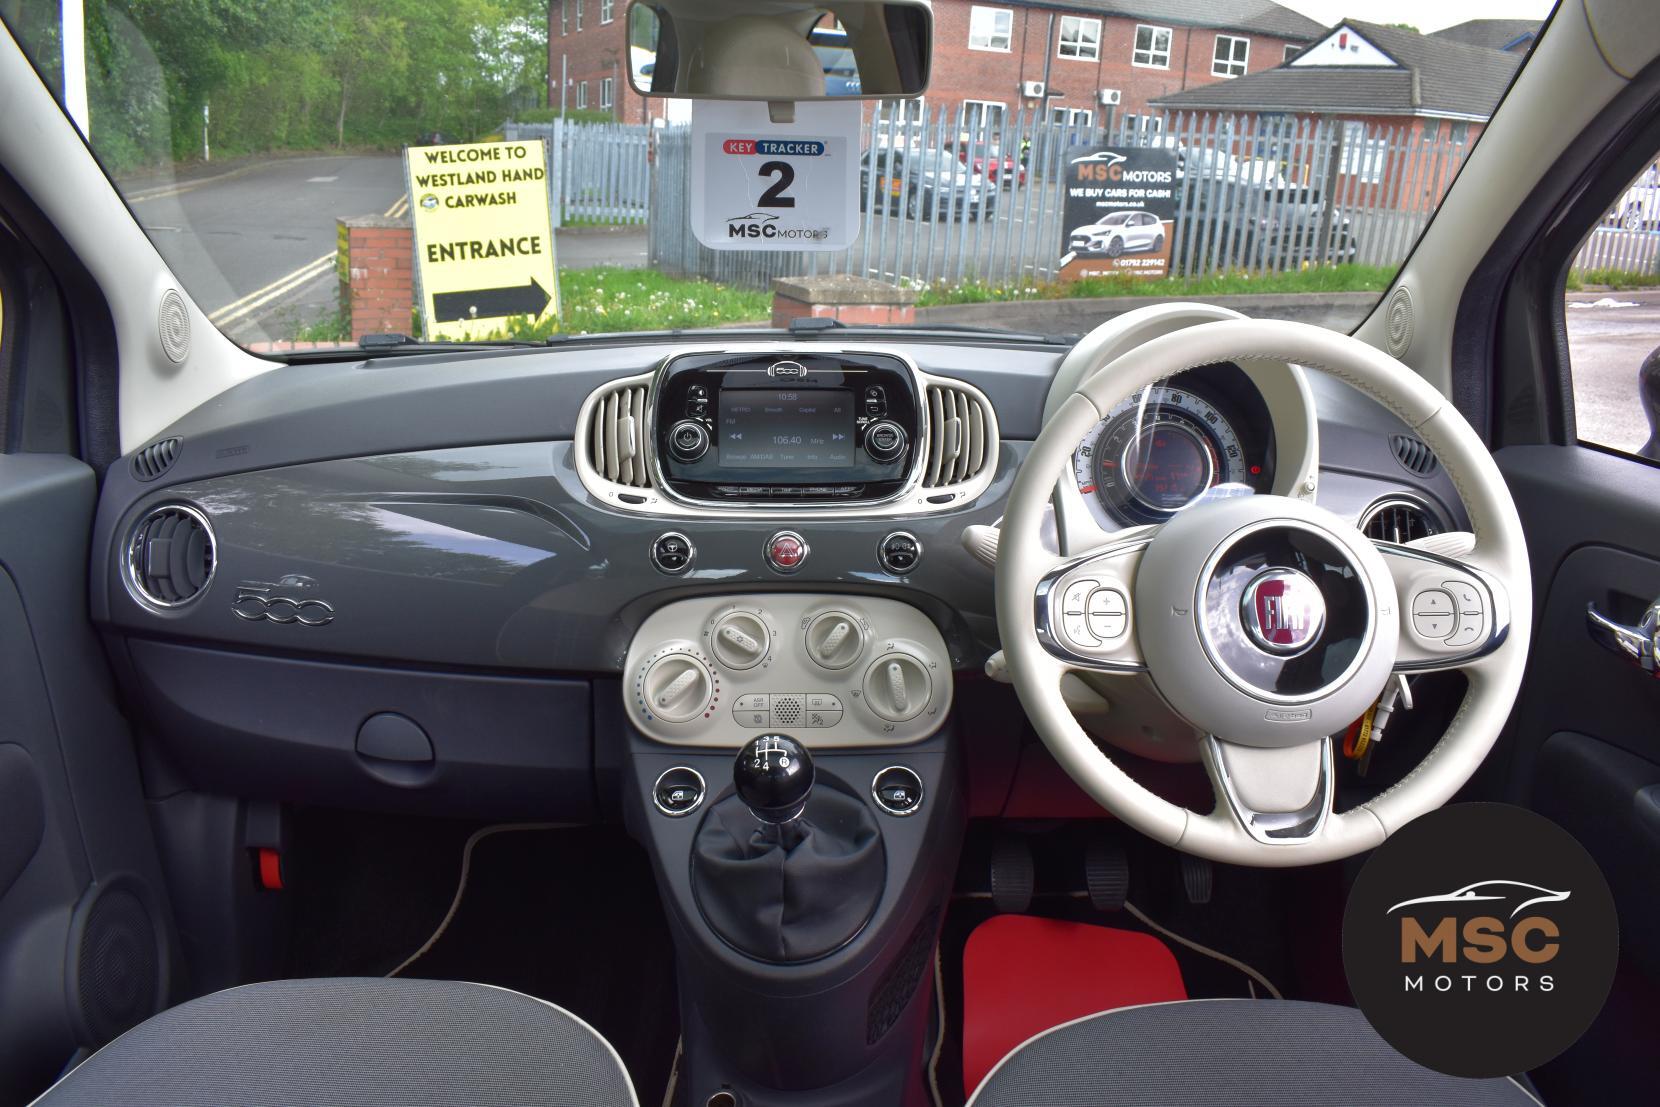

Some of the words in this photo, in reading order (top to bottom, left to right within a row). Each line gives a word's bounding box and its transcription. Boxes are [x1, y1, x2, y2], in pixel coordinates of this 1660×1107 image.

[424, 147, 500, 164] WELCOME
[504, 146, 527, 159] TO
[729, 142, 753, 152] KEY
[762, 143, 819, 154] TRACKER
[416, 169, 497, 188] WESTLAND
[502, 167, 544, 182] HAND
[1078, 164, 1122, 181] MSC
[1122, 170, 1172, 183] MOTORS
[757, 161, 795, 208] 2
[444, 191, 517, 208] CARWASH
[1069, 188, 1085, 197] WE
[1085, 188, 1104, 198] BUY
[1104, 188, 1128, 198] CARS
[1128, 189, 1146, 198] FOR
[728, 223, 777, 238] MSC
[777, 229, 828, 239] MOTORS
[427, 236, 542, 262] ENTRANCE
[1171, 393, 1183, 404] 80
[1204, 411, 1218, 425] 100
[1081, 446, 1092, 458] 20
[1226, 445, 1239, 458] 120
[231, 586, 336, 627] 500
[1264, 595, 1308, 630] FIA
[753, 759, 761, 768] 2
[762, 762, 770, 771] 4
